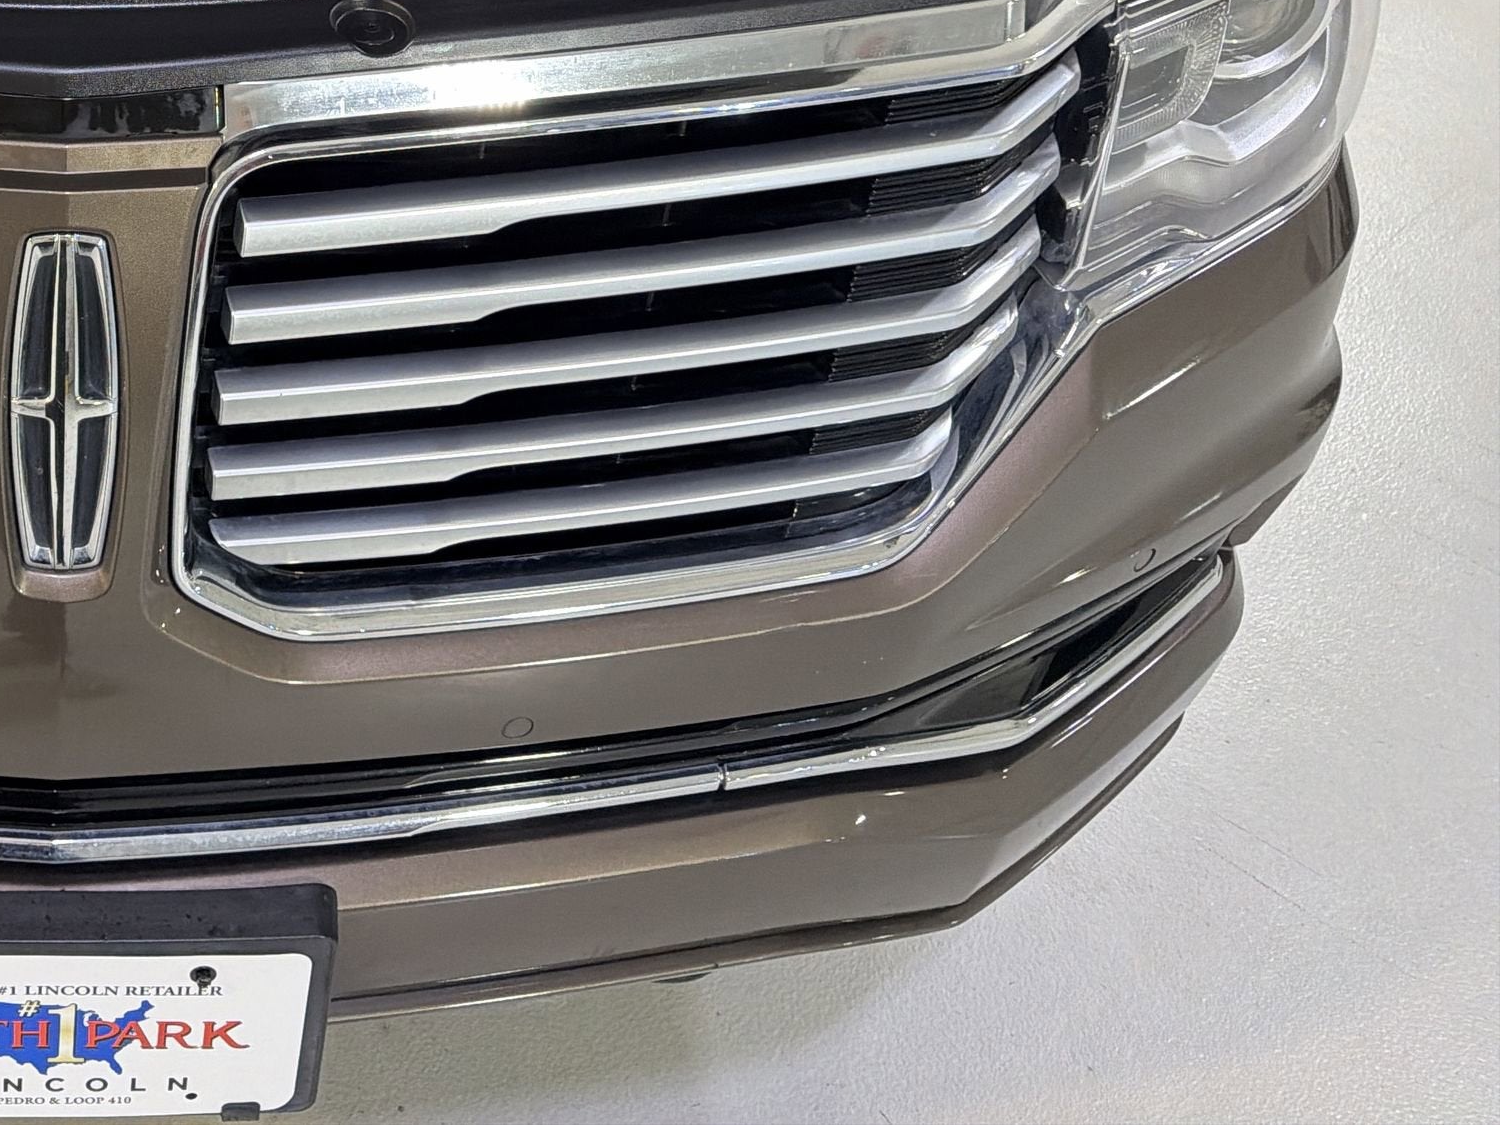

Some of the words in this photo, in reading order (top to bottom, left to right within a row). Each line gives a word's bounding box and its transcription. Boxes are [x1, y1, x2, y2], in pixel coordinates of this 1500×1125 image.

[24, 985, 119, 996] LINCOLN
[124, 985, 223, 996] RETAILER
[84, 1020, 250, 1049] PARK
[49, 1096, 61, 1105] &
[64, 1096, 105, 1105] LOOP
[107, 1096, 132, 1104] 410
